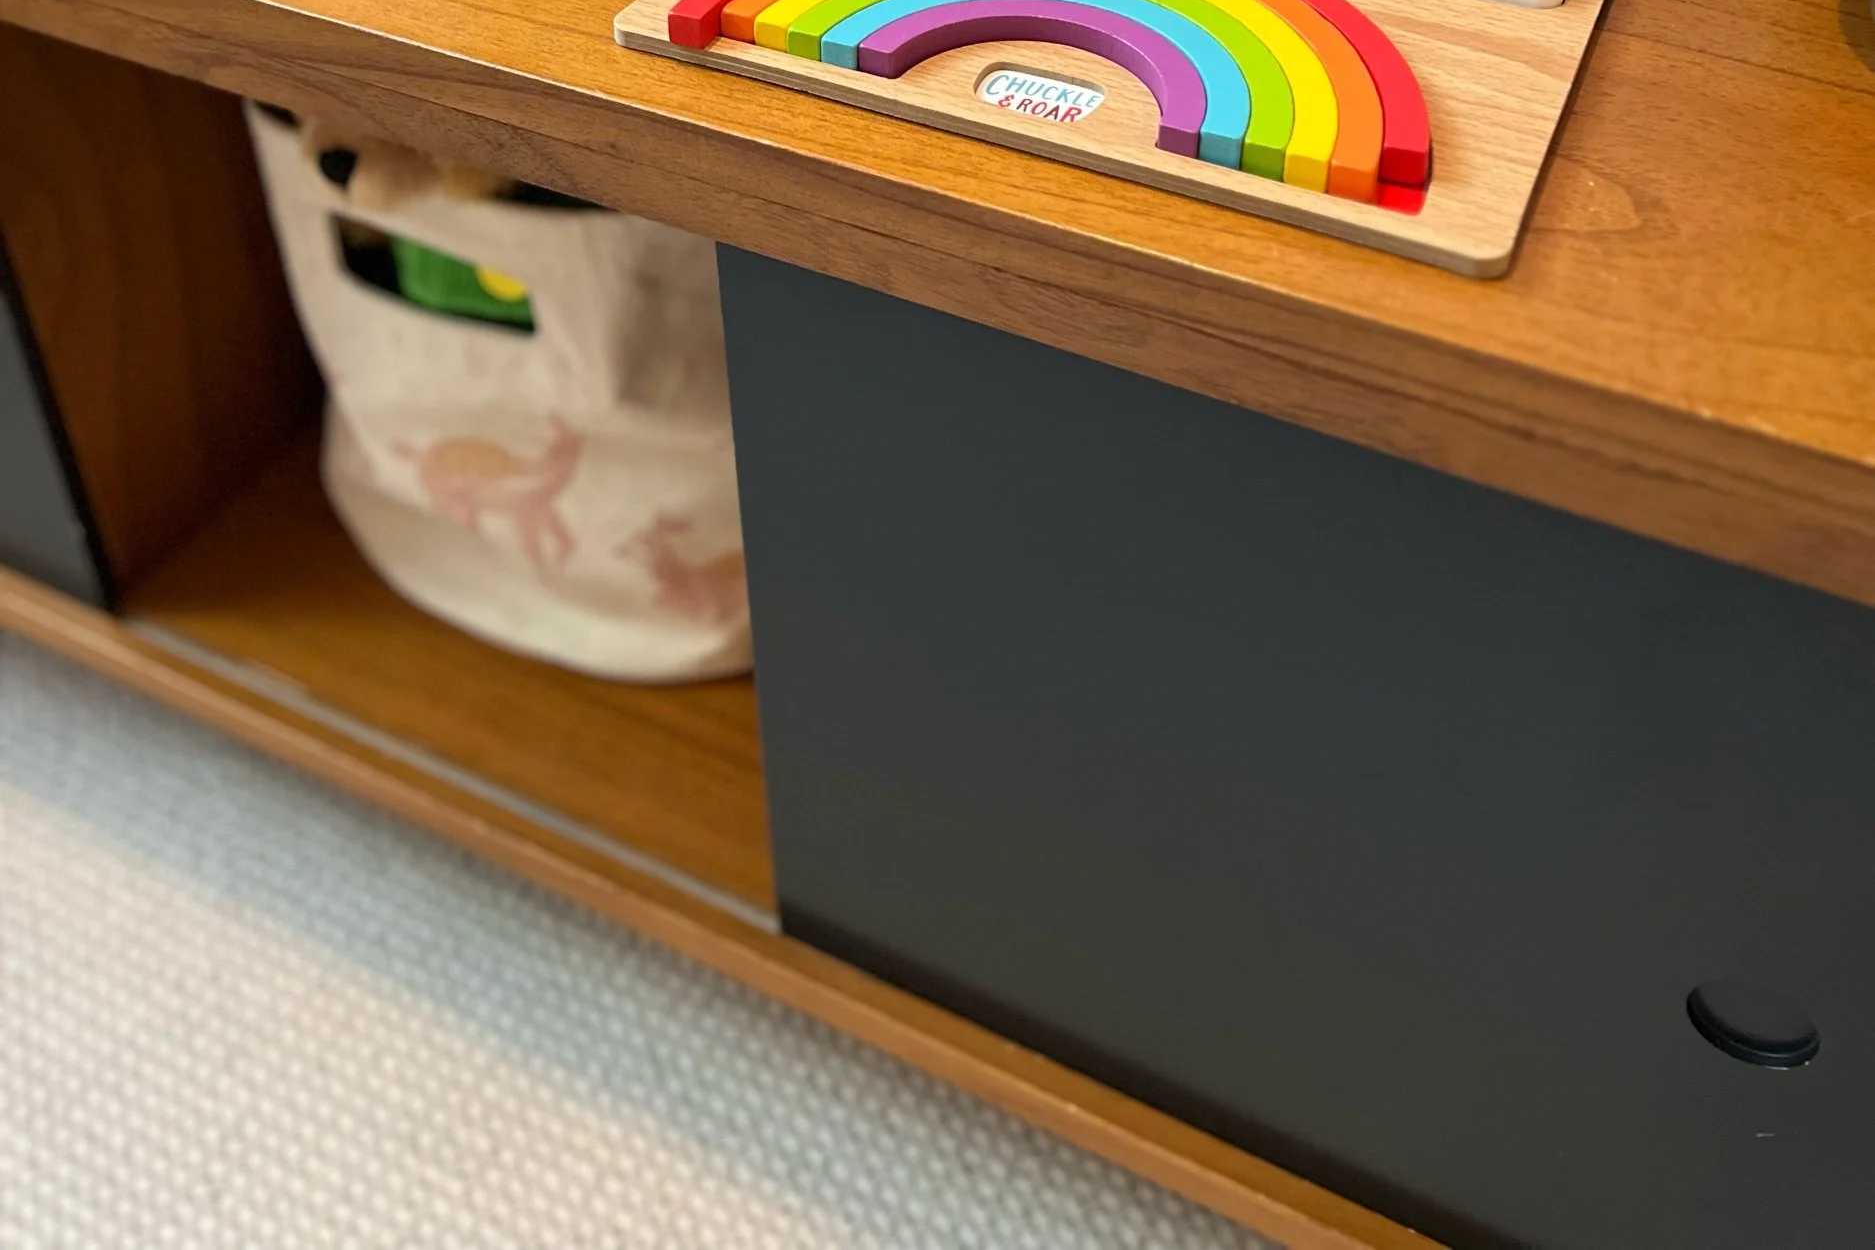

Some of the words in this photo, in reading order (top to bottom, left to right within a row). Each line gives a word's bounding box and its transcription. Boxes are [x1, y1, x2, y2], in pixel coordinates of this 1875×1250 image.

[985, 74, 1100, 109] CHUCKLE
[997, 94, 1015, 109] &
[1016, 98, 1083, 123] ROAR
